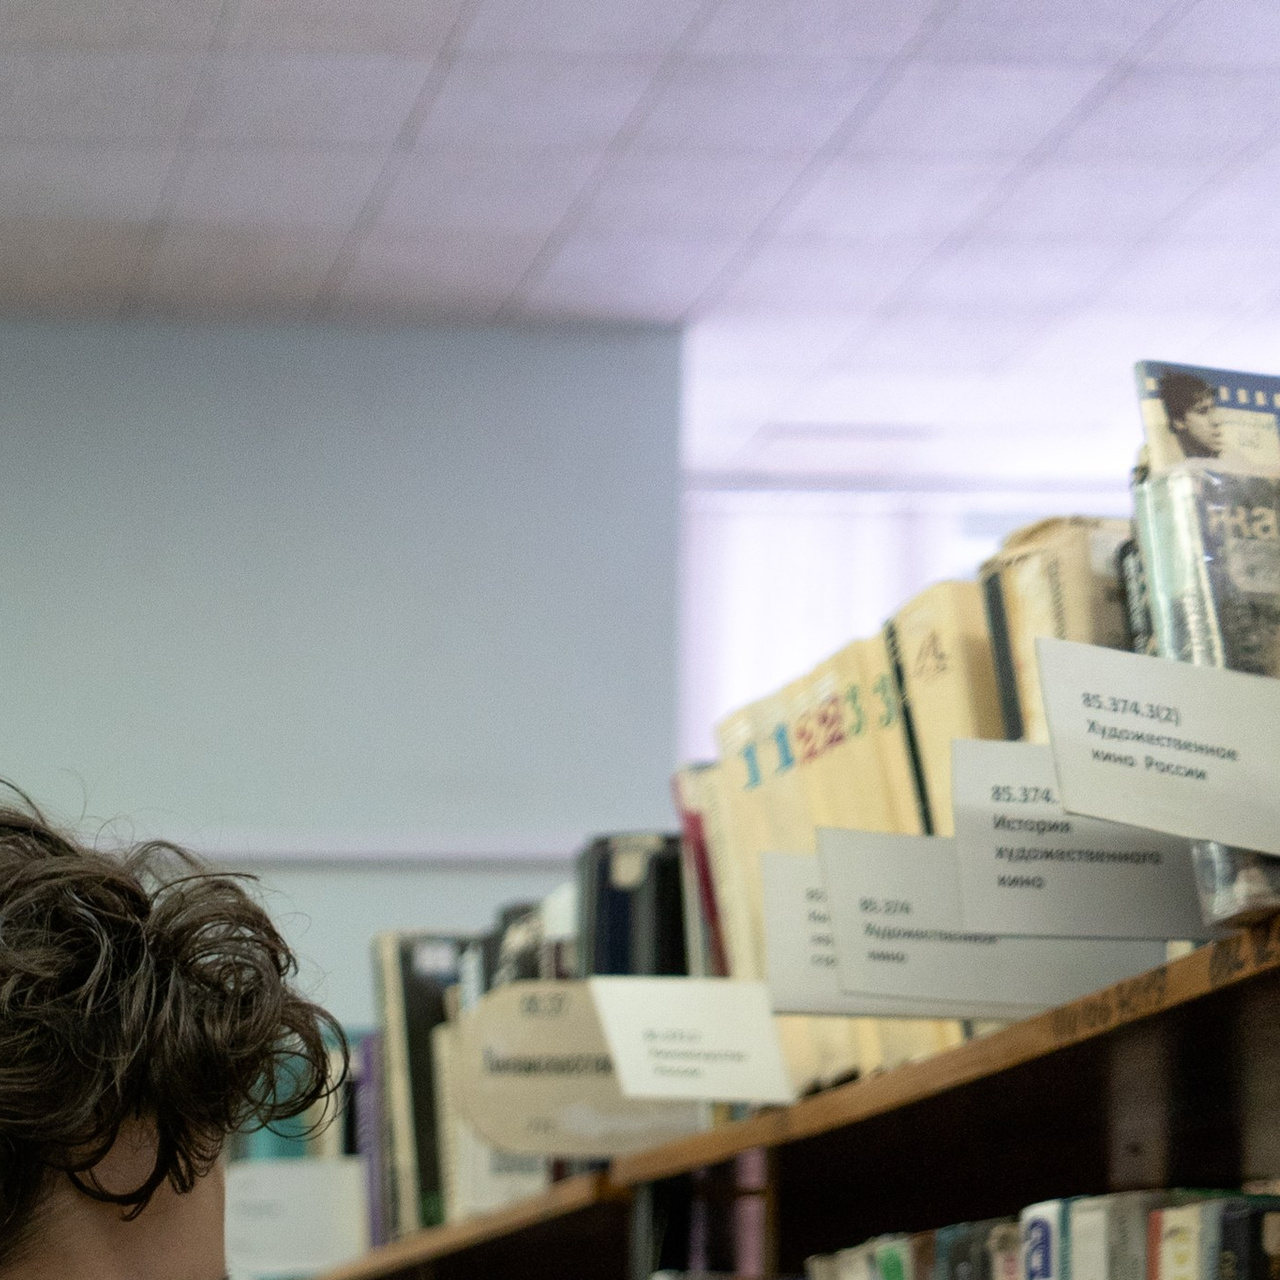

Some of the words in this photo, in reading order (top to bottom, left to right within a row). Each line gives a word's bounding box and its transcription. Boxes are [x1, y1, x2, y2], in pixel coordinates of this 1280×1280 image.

[1086, 718, 1238, 762] Художественное
[1091, 748, 1136, 767] кино
[1144, 755, 1207, 780] России
[993, 813, 1071, 834] История
[995, 846, 1163, 865] художественного
[998, 874, 1045, 889] кино
